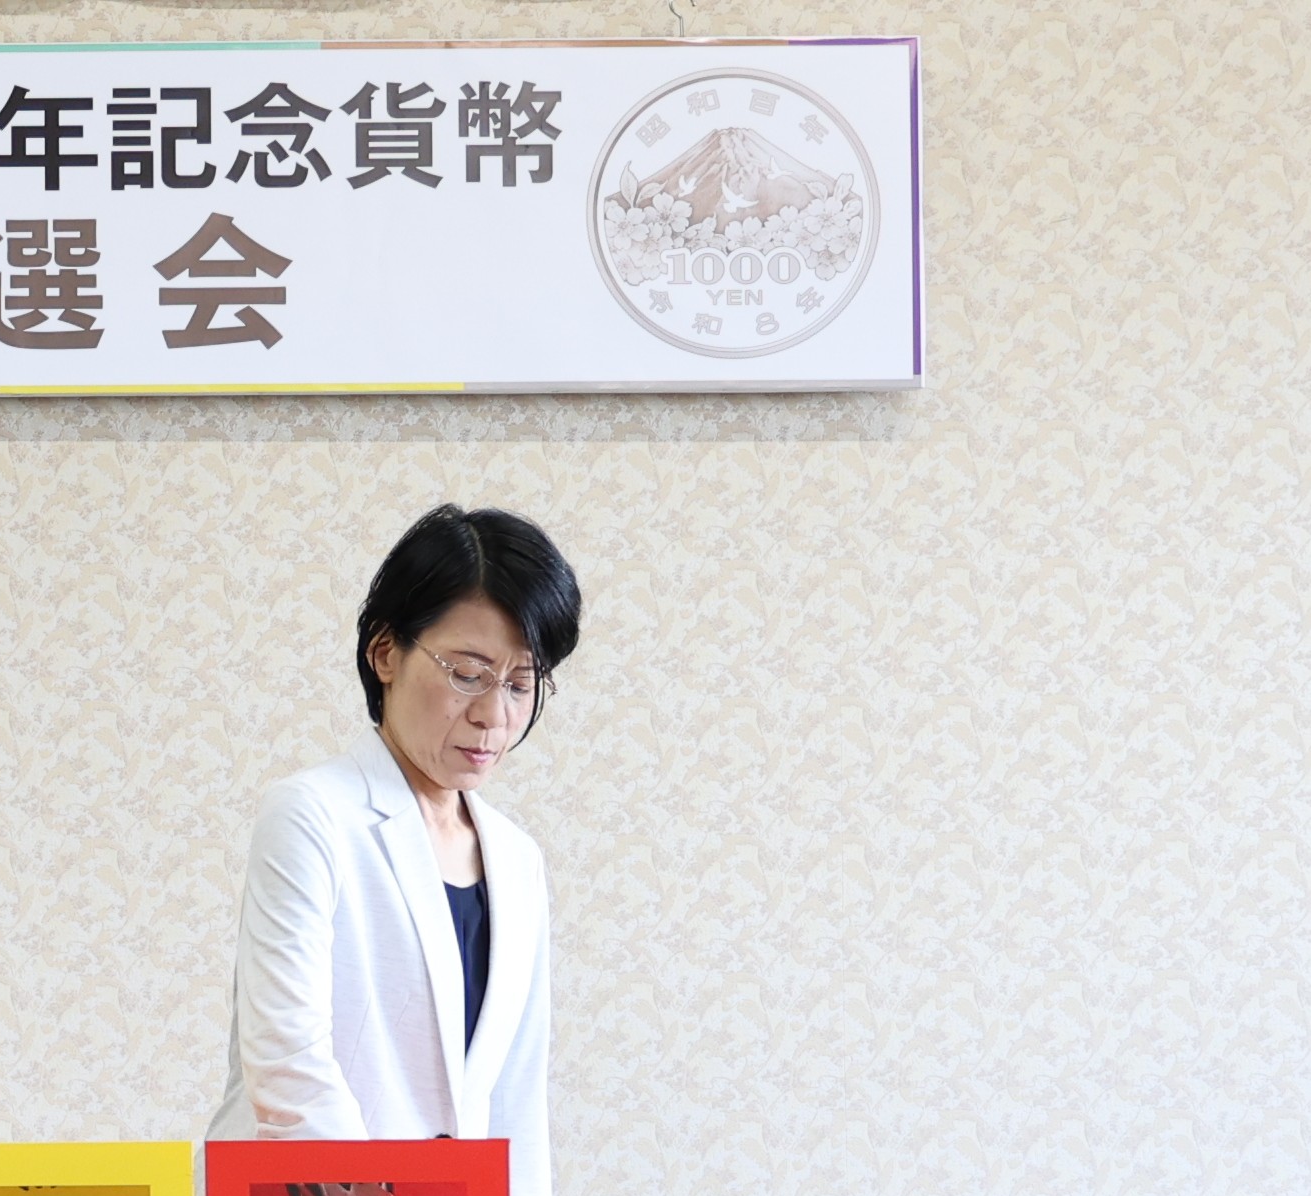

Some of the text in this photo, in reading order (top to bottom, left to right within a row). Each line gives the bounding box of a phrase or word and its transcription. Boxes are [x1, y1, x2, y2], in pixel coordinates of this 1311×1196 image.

[635, 89, 829, 147] 昭和百年
[666, 252, 801, 285] 1000
[705, 289, 764, 306] YEN
